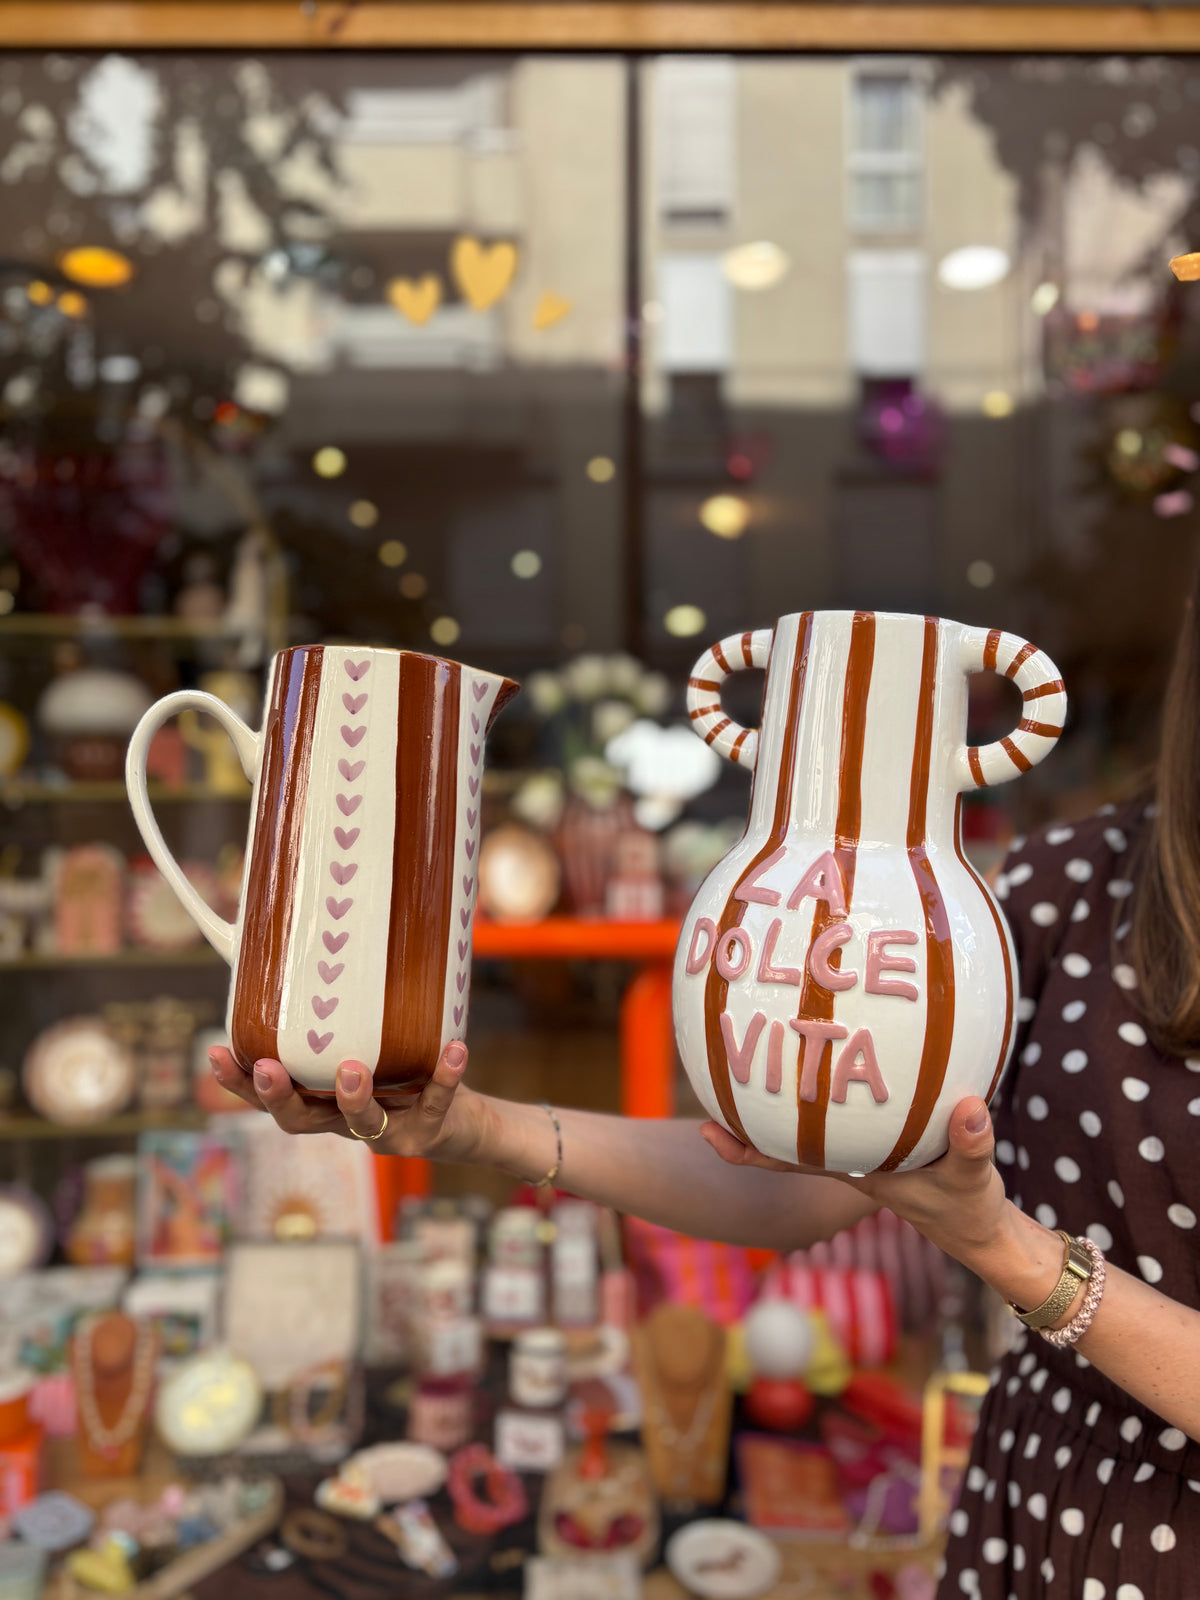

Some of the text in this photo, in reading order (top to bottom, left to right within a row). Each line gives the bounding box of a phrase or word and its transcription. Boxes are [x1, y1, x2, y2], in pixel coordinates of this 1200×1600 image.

[736, 847, 848, 917] LA
[687, 918, 919, 1001] DOLCE
[720, 1012, 889, 1103] VITA
